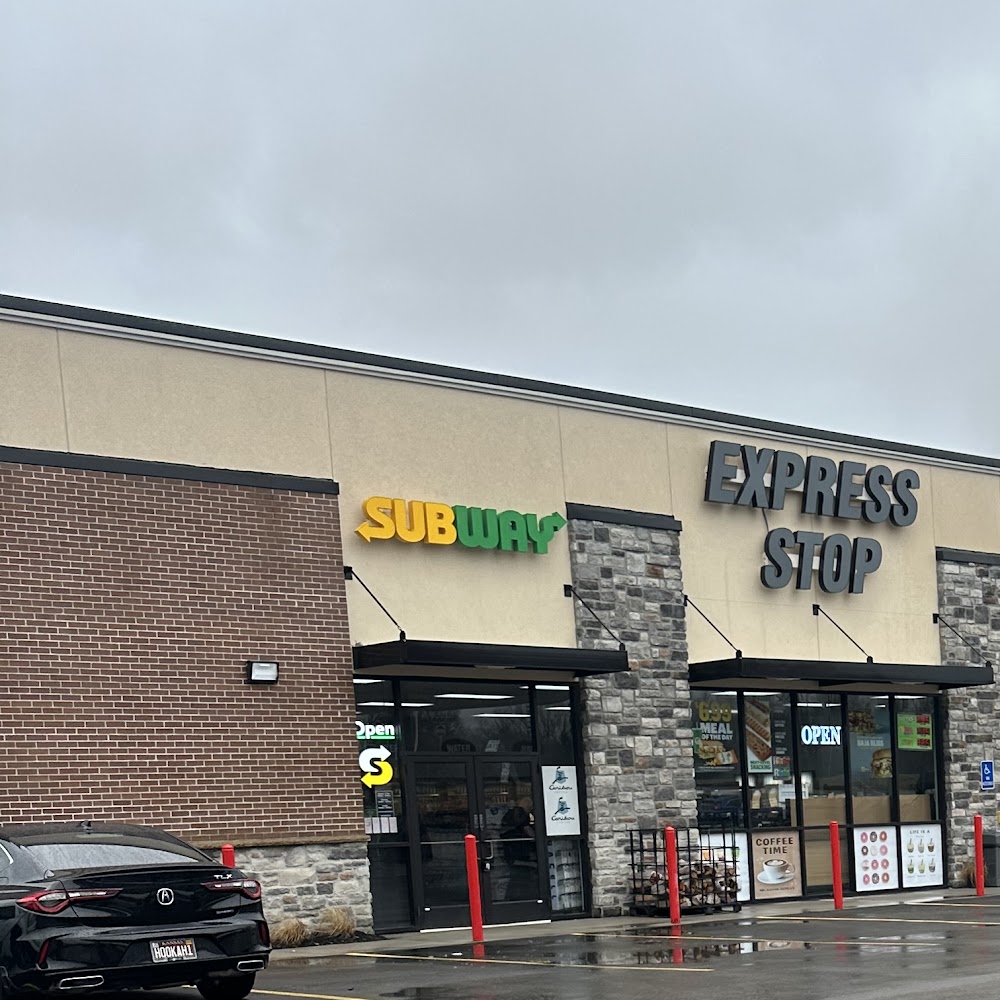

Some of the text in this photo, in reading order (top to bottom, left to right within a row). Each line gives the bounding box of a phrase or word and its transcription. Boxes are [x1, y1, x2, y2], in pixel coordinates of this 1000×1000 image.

[704, 440, 920, 527] EXPRESS
[354, 496, 567, 554] SUBWAY
[760, 527, 882, 594] STOP
[355, 721, 395, 740] Open
[700, 722, 733, 734] MEAL
[800, 725, 842, 745] OPEN
[446, 743, 471, 752] WATER
[755, 837, 794, 846] COFFEE
[763, 846, 788, 854] TIME
